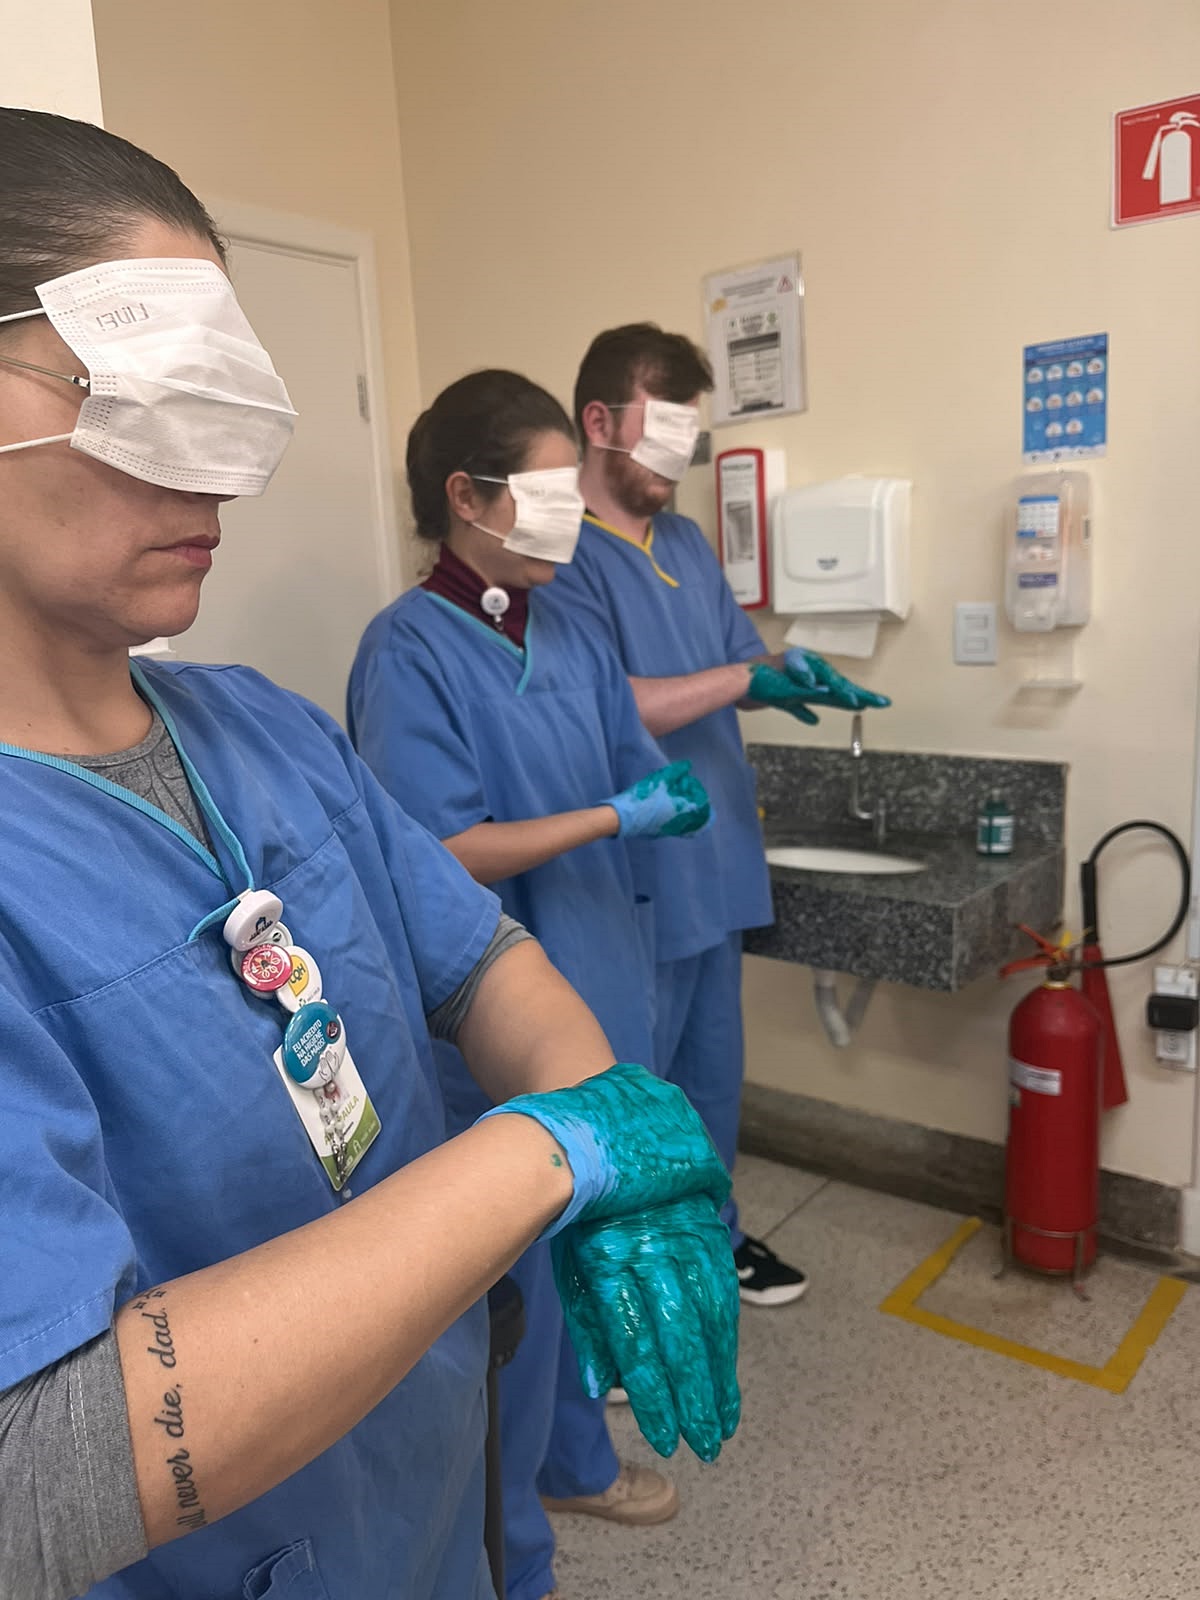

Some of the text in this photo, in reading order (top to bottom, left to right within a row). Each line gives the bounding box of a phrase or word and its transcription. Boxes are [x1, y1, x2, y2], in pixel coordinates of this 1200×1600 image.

[292, 1041, 302, 1053] EU
[301, 1019, 322, 1045] ACREDITO
[296, 1030, 324, 1060] NA HIGIENE
[300, 1052, 313, 1067] DAS
[167, 1448, 199, 1510] never
